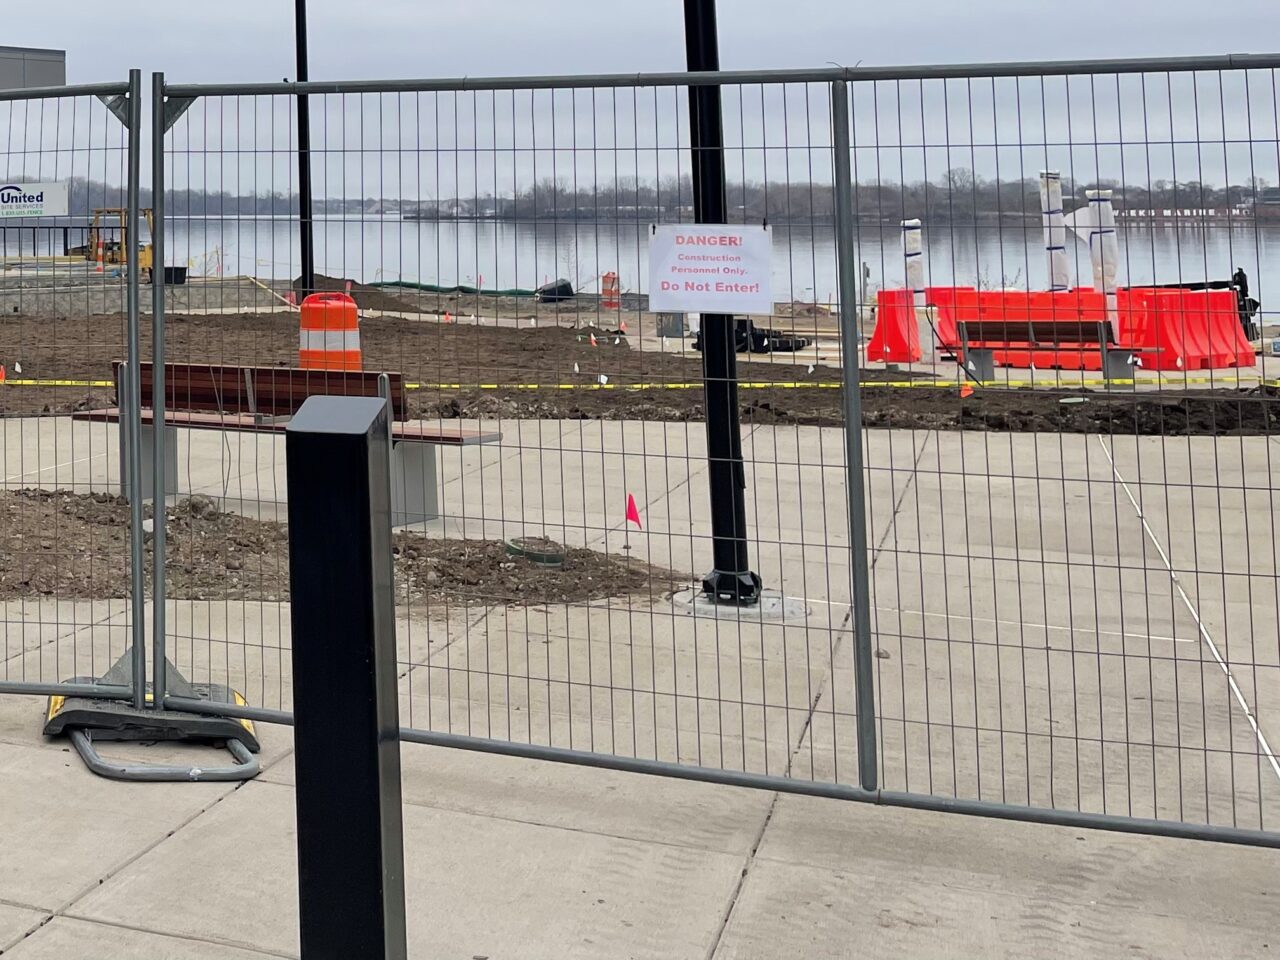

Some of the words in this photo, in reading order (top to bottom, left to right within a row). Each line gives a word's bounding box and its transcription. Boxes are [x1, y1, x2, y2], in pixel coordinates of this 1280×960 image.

[1, 191, 44, 203] United
[675, 235, 743, 246] DANGER!
[677, 253, 742, 262] Construction
[671, 265, 720, 274] Personnel
[723, 266, 748, 276] Only.
[661, 280, 680, 291] Do
[684, 281, 710, 292] Not
[715, 282, 760, 293] Enter!
